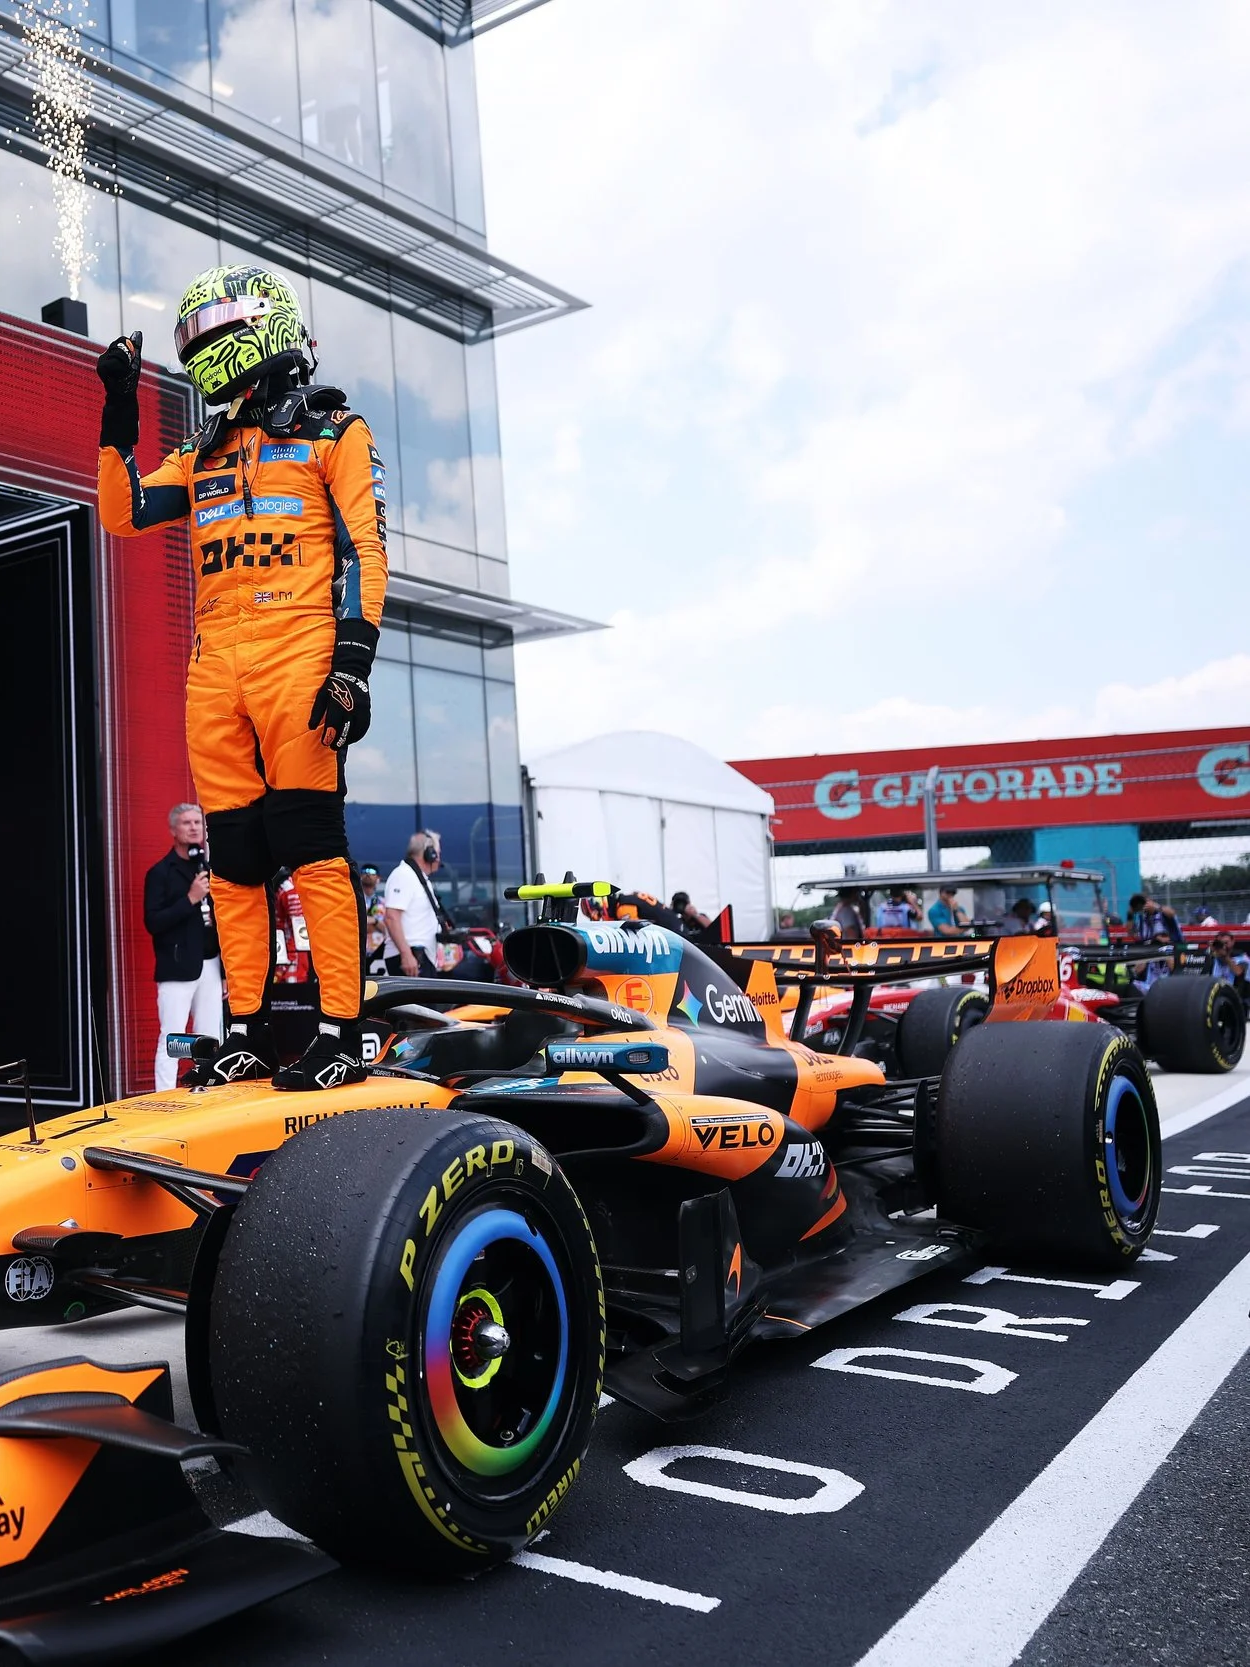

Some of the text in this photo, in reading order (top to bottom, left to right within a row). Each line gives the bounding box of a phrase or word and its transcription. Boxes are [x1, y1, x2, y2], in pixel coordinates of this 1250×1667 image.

[202, 368, 222, 384] Android
[198, 487, 229, 500] DP WORLD
[199, 499, 298, 522] DELL Tecnologies
[871, 762, 1124, 808] GATORADE
[588, 925, 671, 963] allwyn
[1016, 978, 1055, 996] Dropbox
[611, 1007, 632, 1024] okta
[553, 1049, 614, 1067] allwyn
[372, 1069, 391, 1077] NORRIS
[693, 1122, 775, 1151] VELO
[400, 1238, 417, 1293] P
[418, 1139, 515, 1237] ZERO
